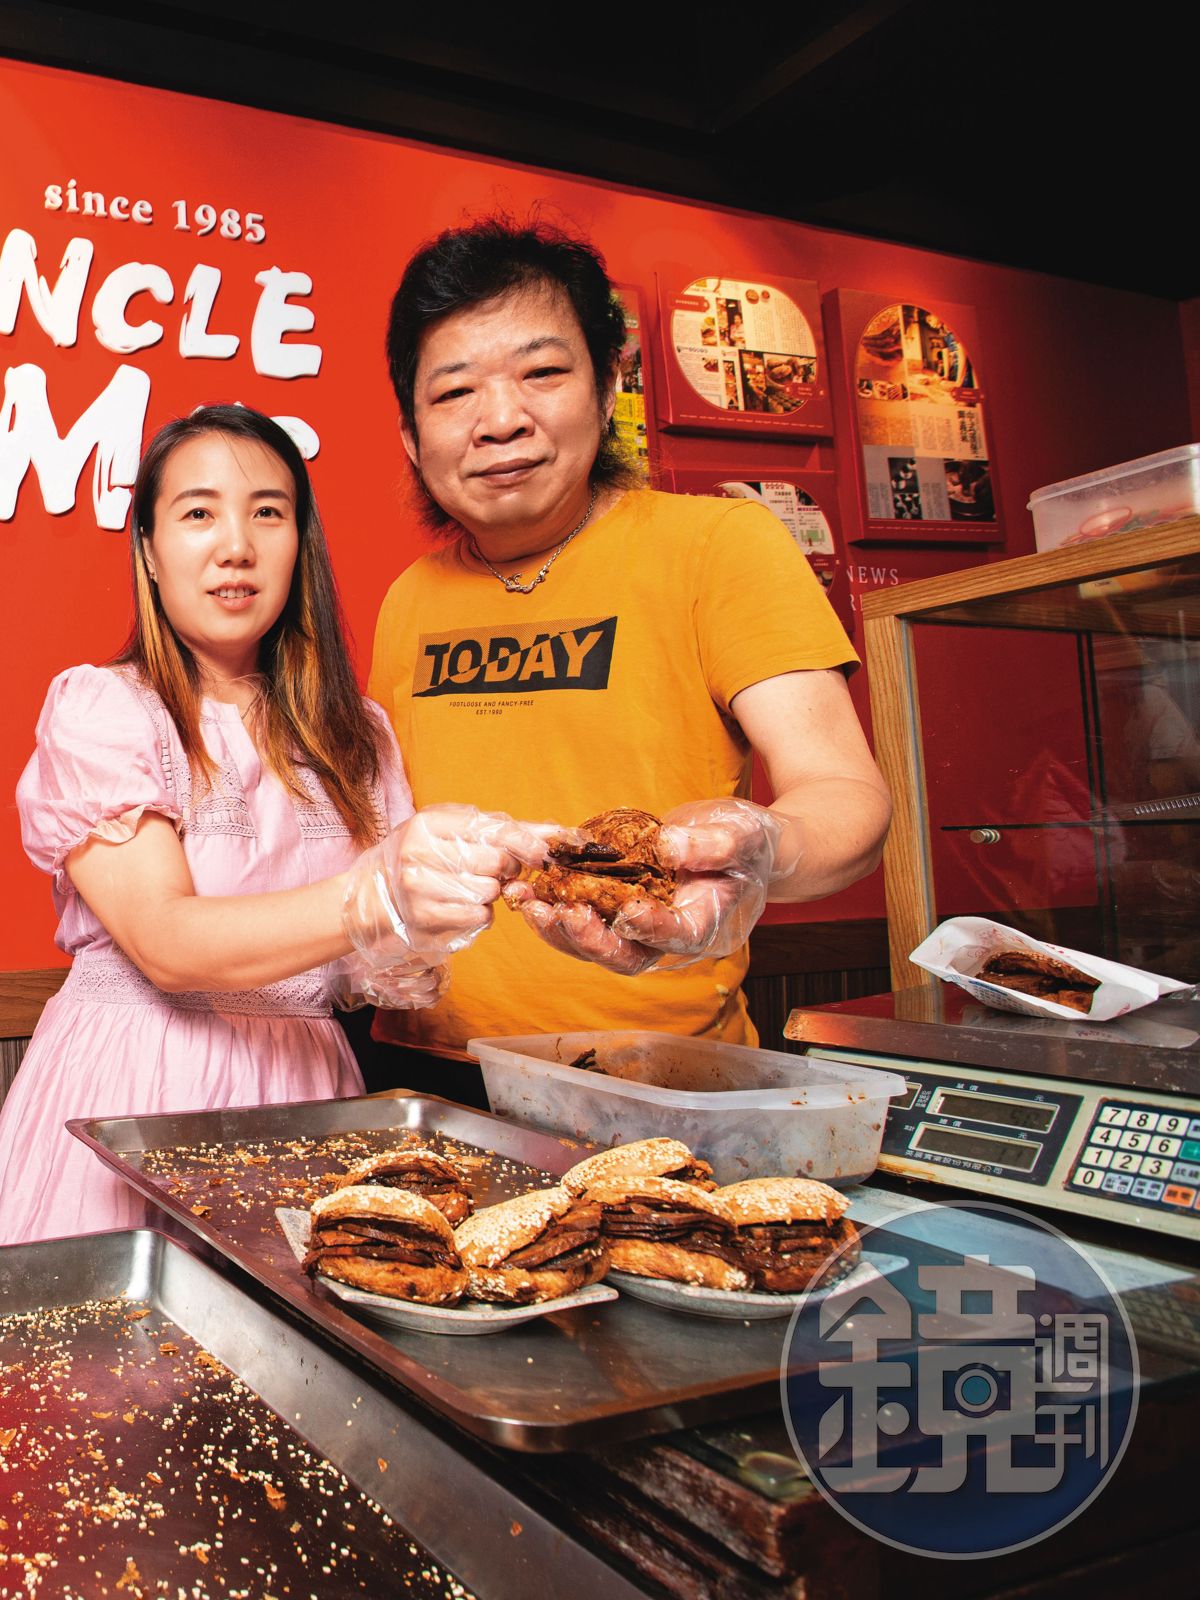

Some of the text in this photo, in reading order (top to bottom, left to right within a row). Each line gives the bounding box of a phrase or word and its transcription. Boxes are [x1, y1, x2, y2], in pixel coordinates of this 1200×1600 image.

[44, 179, 267, 246] since 1985
[846, 565, 899, 586] NEWS
[424, 630, 604, 687] TODAY
[1111, 1108, 1121, 1123] 7
[1136, 1113, 1149, 1127] 8
[1166, 1118, 1179, 1132] 9
[1099, 1129, 1171, 1153] 4 5 6
[1095, 1150, 1162, 1175] 1 2 3
[1082, 1170, 1095, 1185] 0
